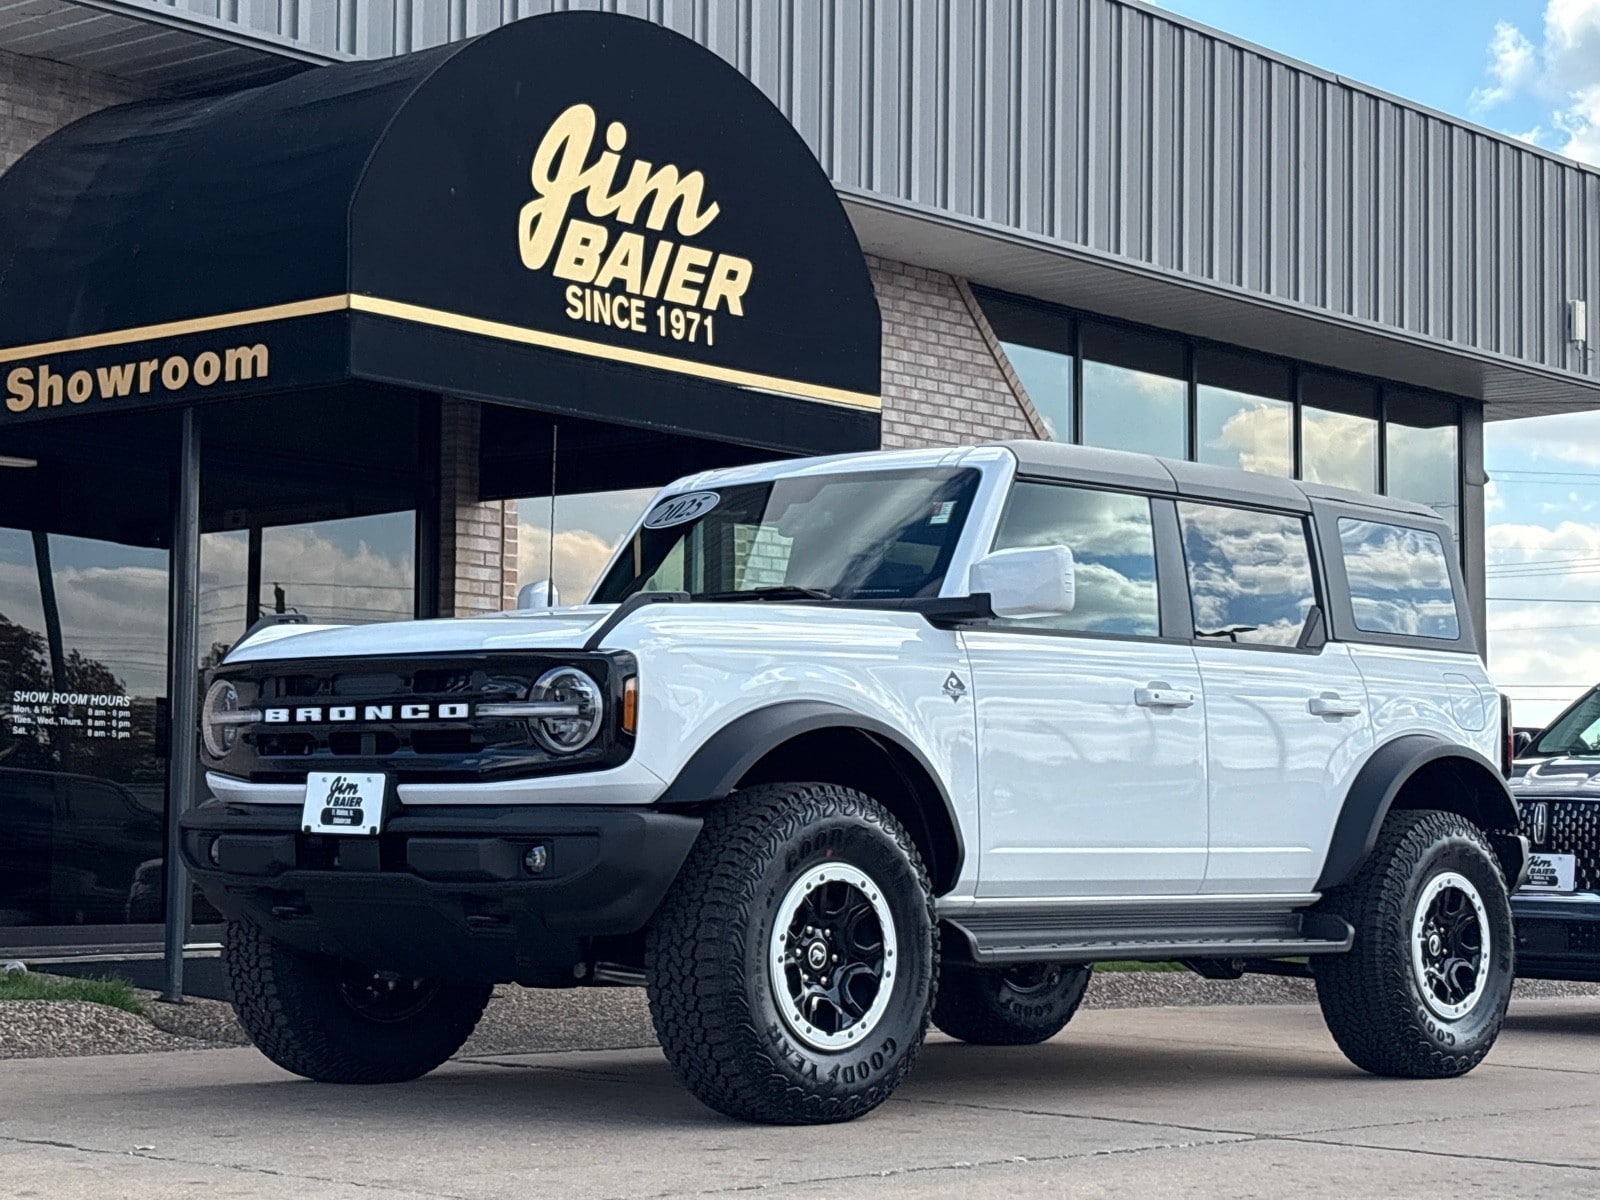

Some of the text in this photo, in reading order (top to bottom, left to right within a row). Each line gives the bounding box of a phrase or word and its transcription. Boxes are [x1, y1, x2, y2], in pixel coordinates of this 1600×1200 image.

[518, 103, 720, 270] Jim
[552, 218, 753, 317] BAIER
[565, 285, 714, 346] SINCE 1971
[6, 343, 269, 412] Showroom
[651, 496, 711, 525] 2025
[13, 690, 131, 707] SHOW ROOM HOURS
[12, 705, 32, 714] Mon.
[34, 705, 40, 714] &
[118, 710, 131, 718] pm
[264, 703, 469, 723] BRONCO
[118, 720, 131, 728] pm
[118, 731, 130, 740] pm
[326, 776, 358, 806] Jim
[332, 796, 363, 807] BAIER
